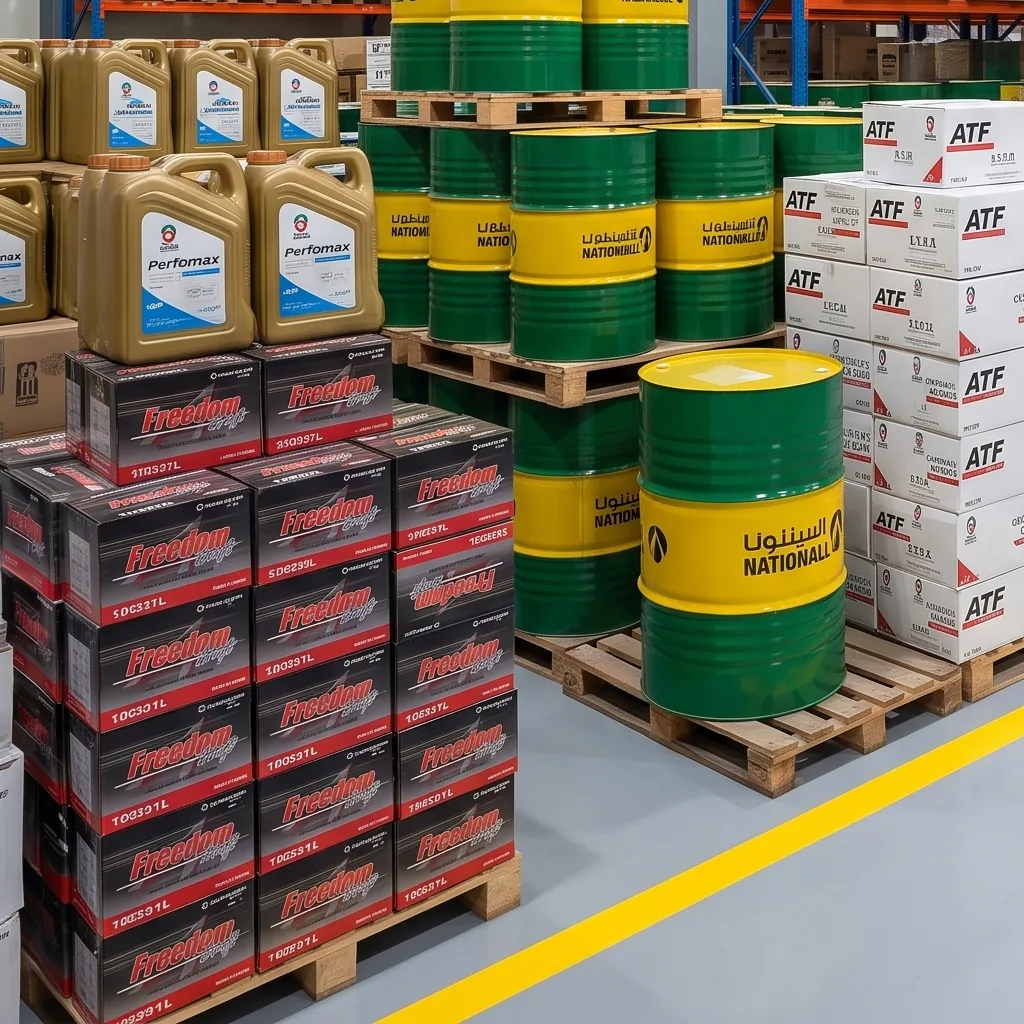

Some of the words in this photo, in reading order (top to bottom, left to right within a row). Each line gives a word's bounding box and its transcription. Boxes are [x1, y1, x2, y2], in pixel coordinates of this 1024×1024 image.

[866, 121, 895, 138] ATF
[950, 121, 991, 144] ATF
[786, 190, 817, 210] ATF
[870, 199, 904, 219] ATF
[964, 206, 1005, 232] ATF
[285, 243, 350, 258] Perfomax
[477, 236, 510, 247] NATIO
[148, 254, 220, 271] Perfomax
[788, 269, 821, 289] ATF
[874, 288, 906, 307] ATF
[965, 366, 1005, 396] ATF
[142, 396, 241, 433] Freedom
[965, 439, 1004, 470] ATF
[280, 495, 373, 535] Freedom
[876, 511, 905, 531] ATF
[125, 526, 231, 573] Freedom
[744, 542, 830, 576] NATIONALL
[279, 587, 371, 632] Freedom
[965, 586, 1005, 621] ATF
[126, 627, 231, 677] Freedom
[281, 679, 373, 727] Freedom
[127, 725, 233, 780] Freedom
[283, 771, 375, 823] Freedom
[130, 823, 235, 881] Freedom
[282, 863, 373, 919] Freedom
[130, 920, 235, 983] Freedom
